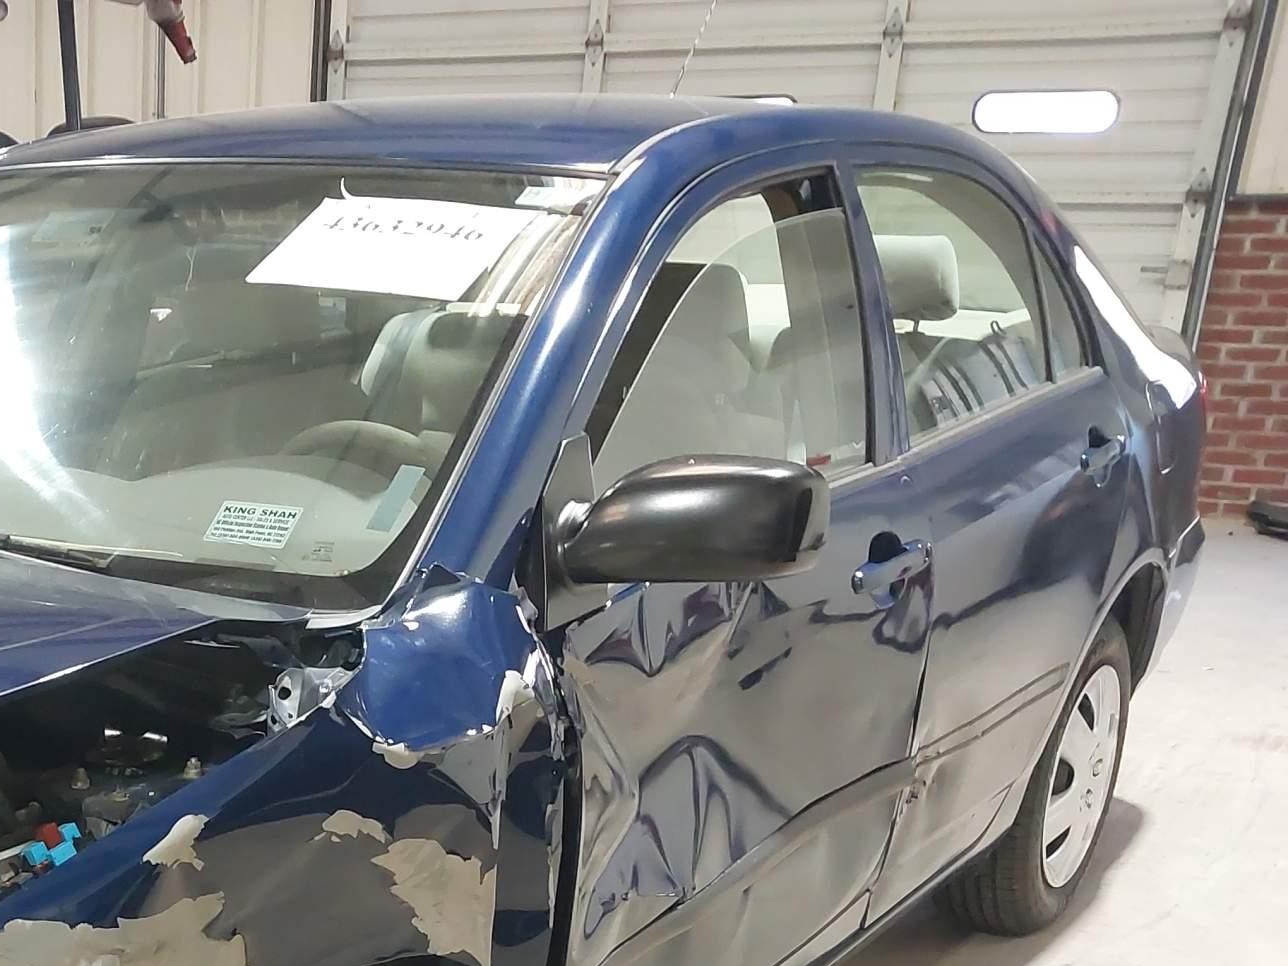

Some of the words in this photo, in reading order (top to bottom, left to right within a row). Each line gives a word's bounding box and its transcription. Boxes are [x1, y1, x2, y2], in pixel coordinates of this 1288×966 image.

[323, 215, 484, 241] 43632946
[223, 505, 257, 515] KING
[259, 508, 297, 519] SHAH
